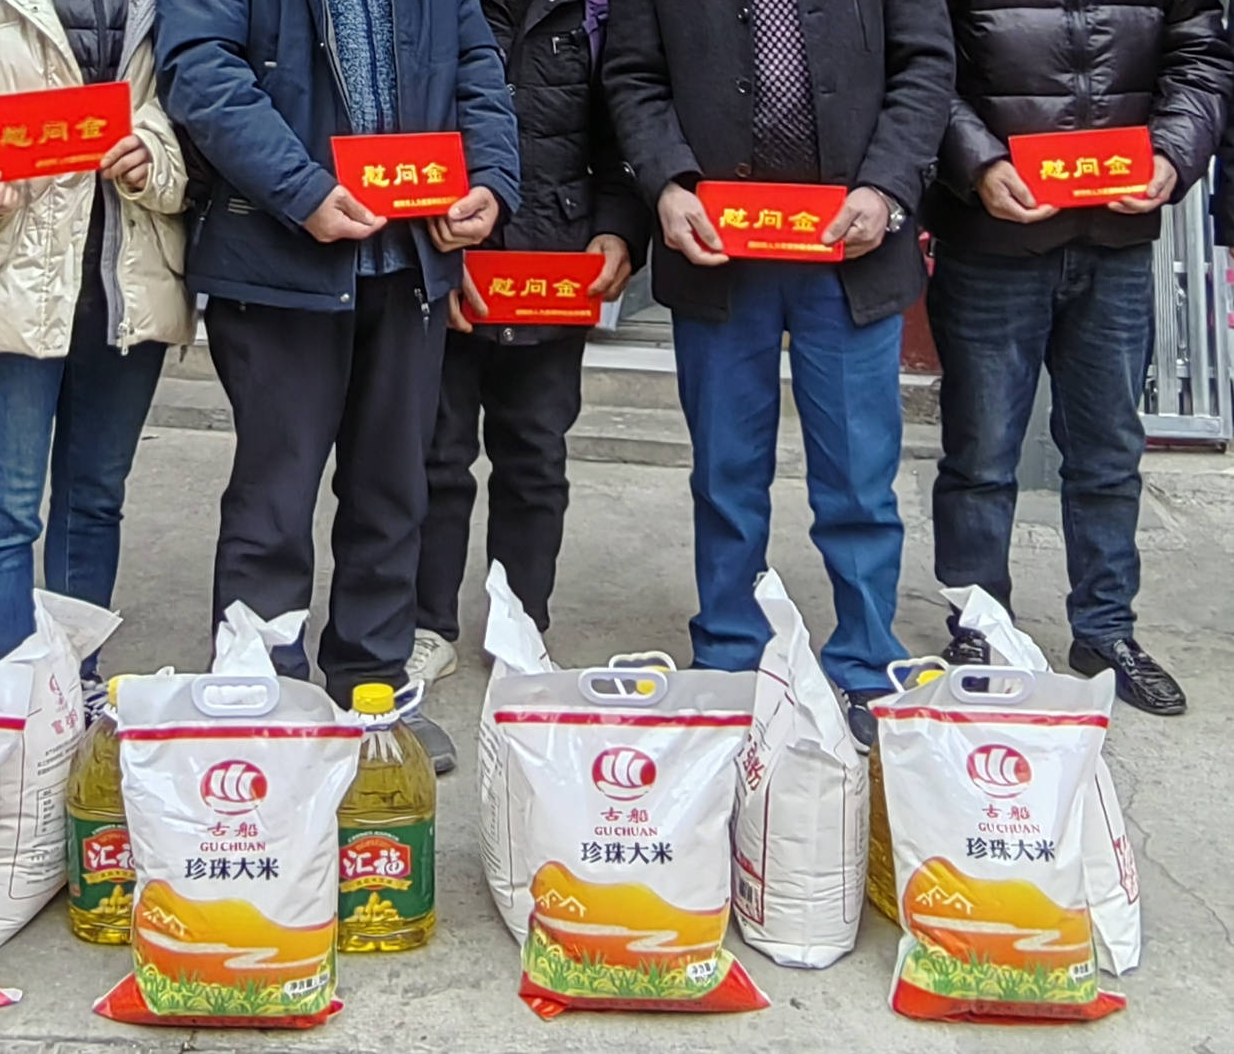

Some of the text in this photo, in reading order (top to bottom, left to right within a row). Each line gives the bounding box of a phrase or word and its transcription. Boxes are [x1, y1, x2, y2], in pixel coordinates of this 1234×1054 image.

[361, 161, 448, 188] 慰问金
[1039, 154, 1133, 181] 慰问金
[719, 208, 820, 232] 慰问金
[488, 277, 582, 298] 慰问金
[600, 806, 649, 824] 古船
[982, 803, 1030, 821] 古船
[207, 821, 259, 838] 古船
[581, 841, 673, 864] 珍珠大米
[966, 837, 1055, 863] 珍珠大米
[184, 857, 279, 880] 珍珠大米
[343, 848, 405, 876] 汇福
